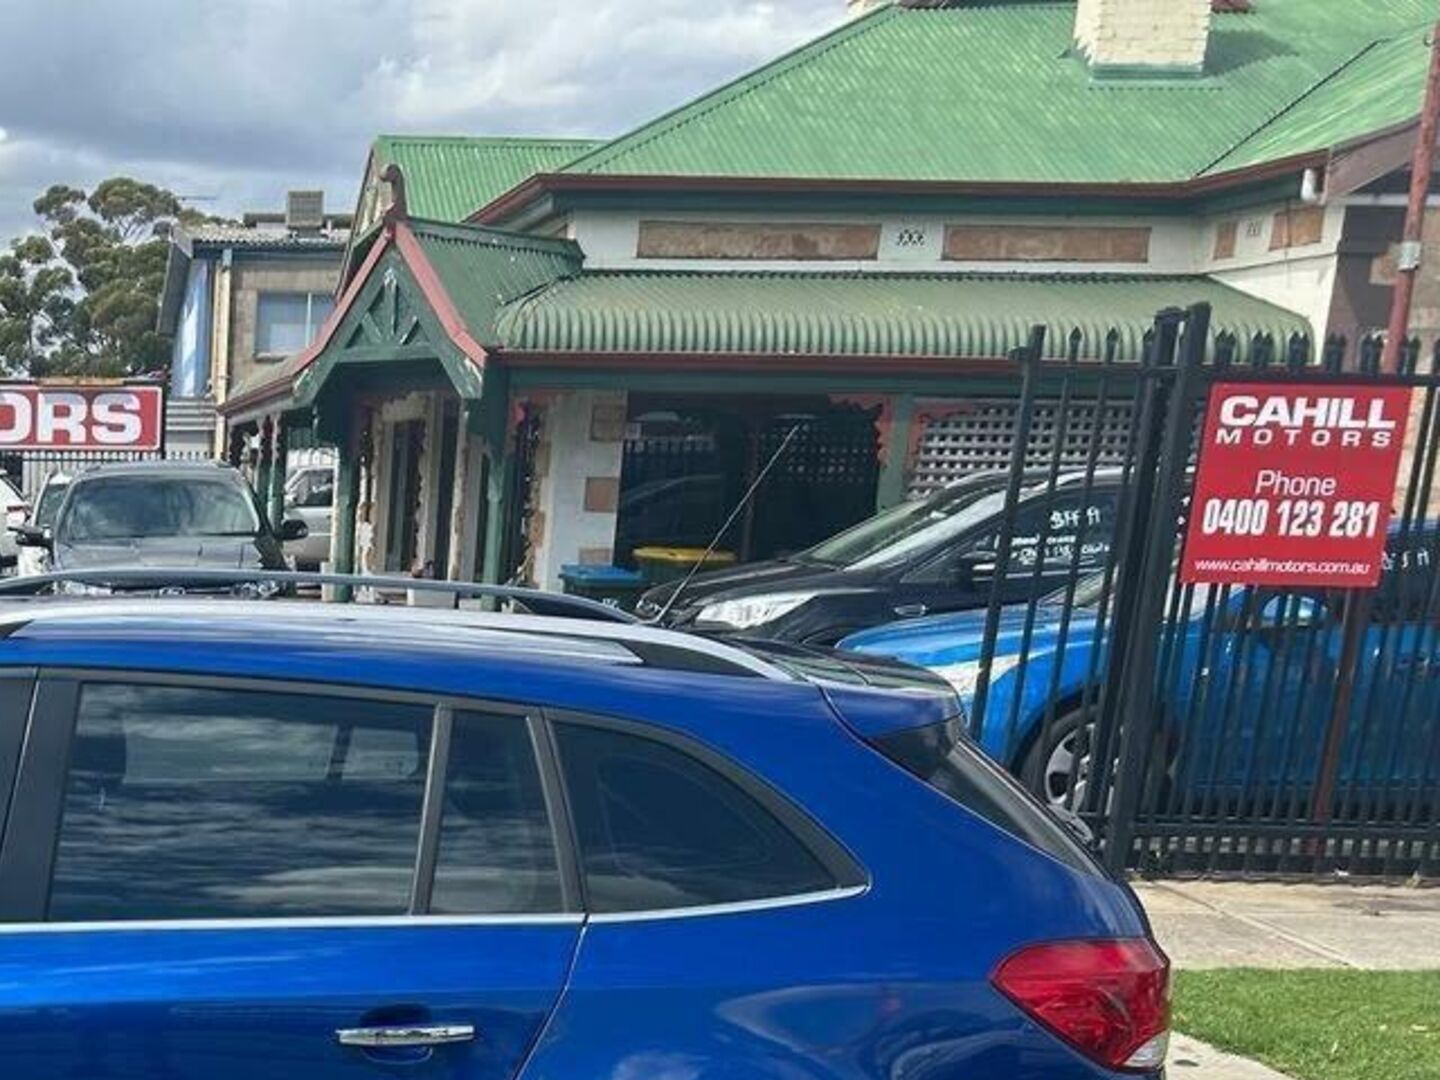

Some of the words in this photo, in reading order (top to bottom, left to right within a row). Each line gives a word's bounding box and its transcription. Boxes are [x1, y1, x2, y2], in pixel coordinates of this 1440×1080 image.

[1219, 395, 1396, 429] CAHILL
[1215, 428, 1392, 446] MOTORS
[1255, 469, 1337, 496] Phone
[1202, 498, 1269, 535] 0400
[1276, 500, 1325, 537] 123
[1329, 501, 1380, 538] 281
[1195, 558, 1371, 575] www.cahillmotors.com.au
